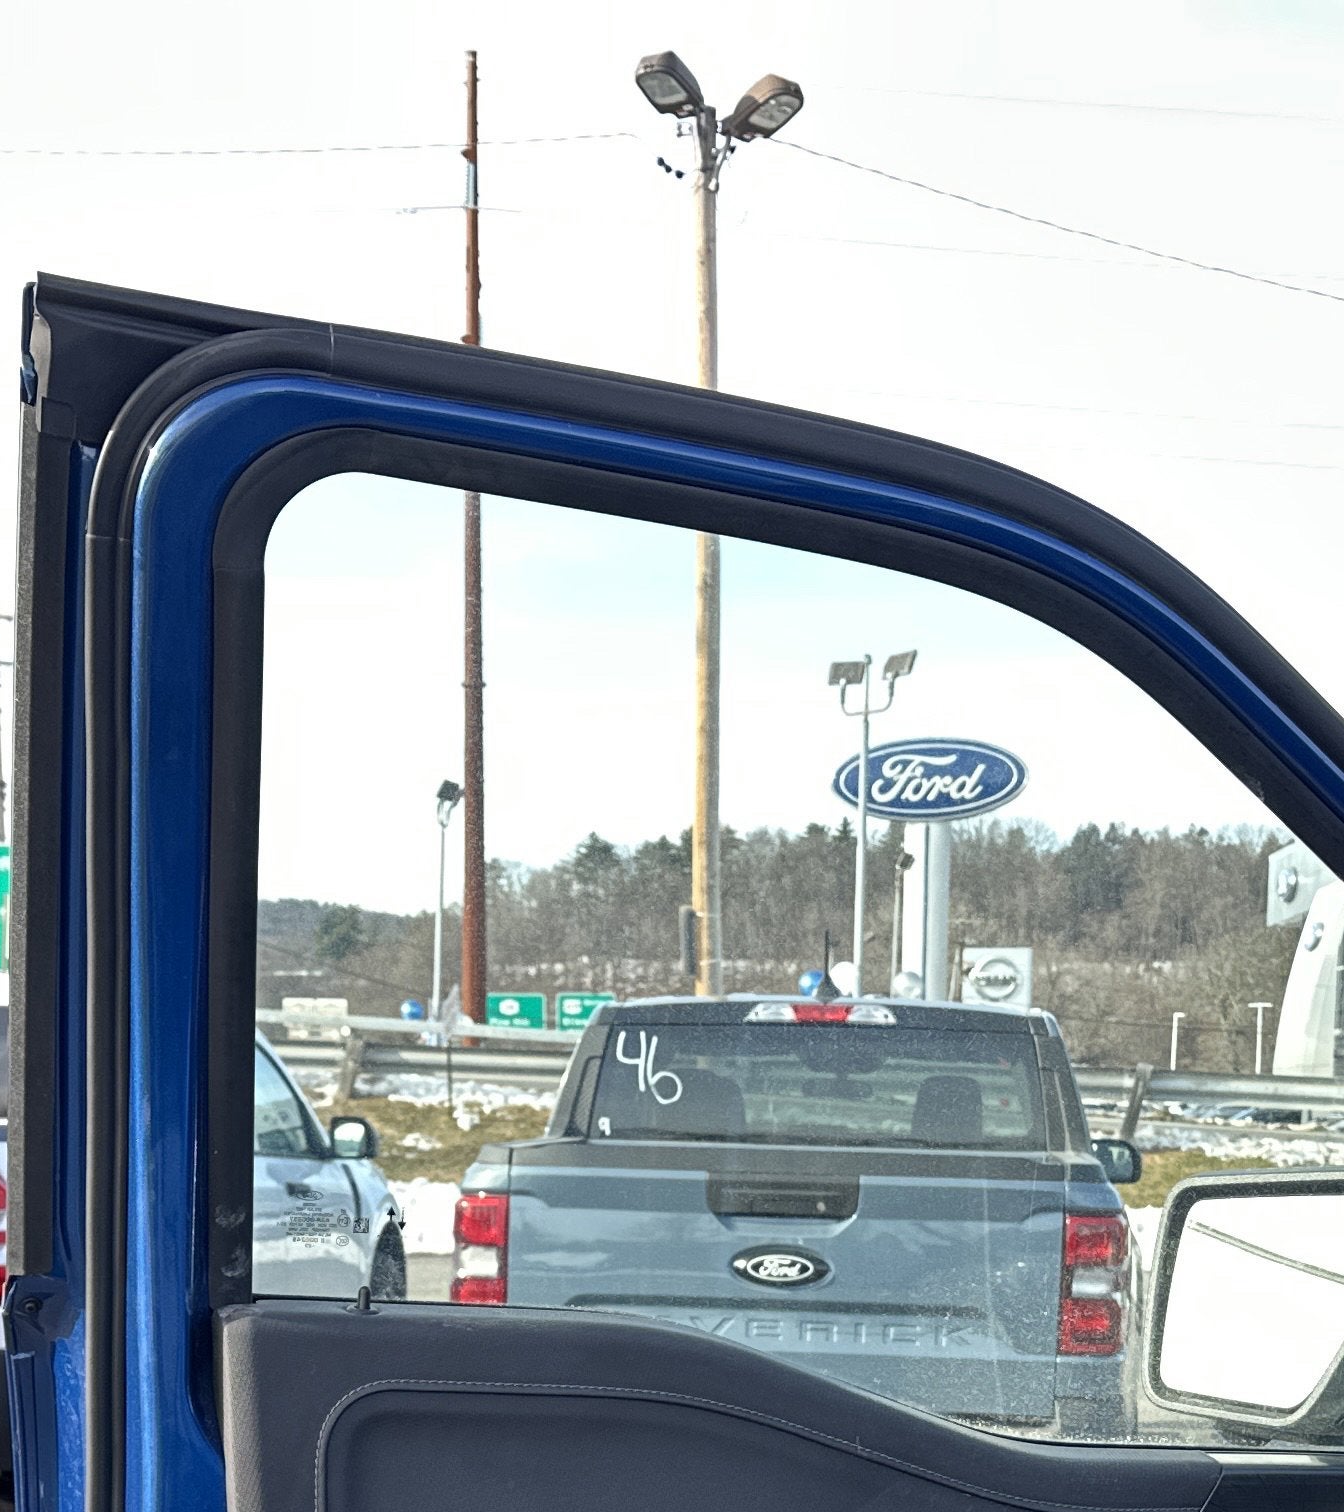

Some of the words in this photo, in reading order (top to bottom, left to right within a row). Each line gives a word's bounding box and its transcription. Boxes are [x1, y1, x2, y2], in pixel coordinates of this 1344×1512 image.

[871, 753, 986, 803] Ford
[615, 1030, 683, 1105] 46
[758, 1259, 802, 1277] Ford
[656, 1314, 978, 1347] VERICK
